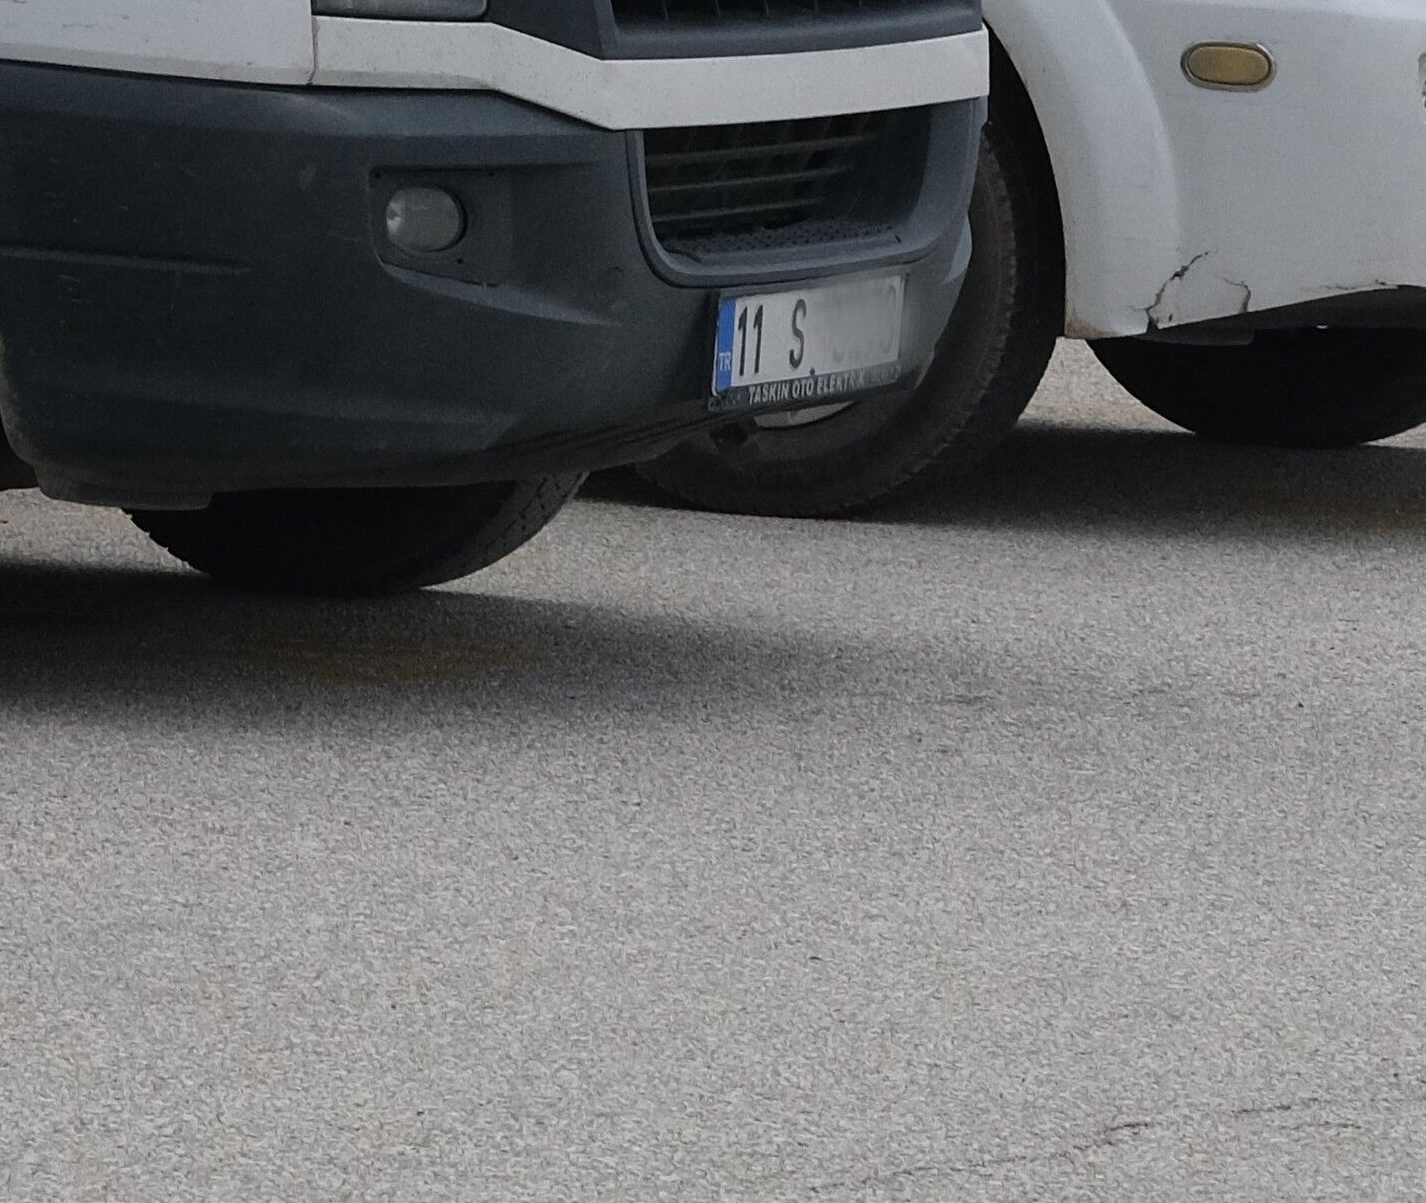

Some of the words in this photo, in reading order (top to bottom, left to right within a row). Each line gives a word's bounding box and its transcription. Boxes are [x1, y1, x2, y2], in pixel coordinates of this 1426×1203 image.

[737, 304, 764, 376] 11
[789, 298, 807, 369] S
[718, 352, 732, 371] TR
[792, 377, 814, 399] OTO
[817, 369, 864, 396] ELEKTRK
